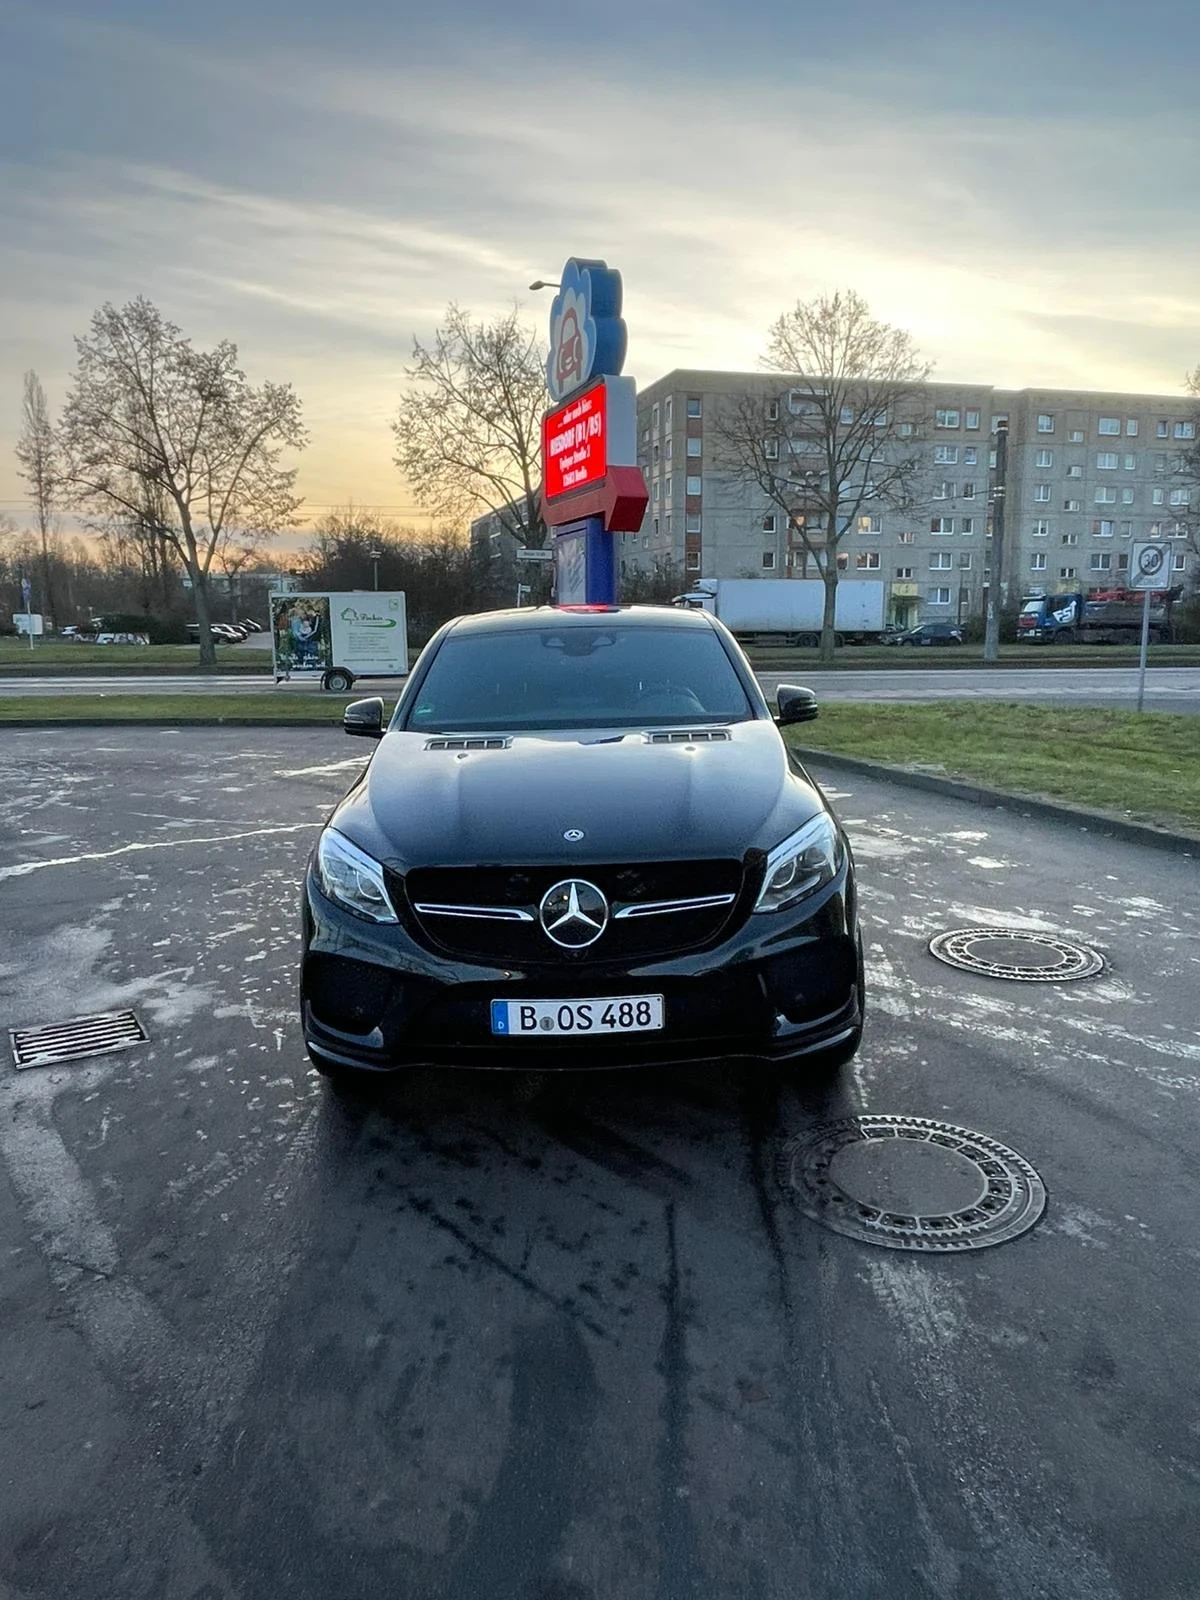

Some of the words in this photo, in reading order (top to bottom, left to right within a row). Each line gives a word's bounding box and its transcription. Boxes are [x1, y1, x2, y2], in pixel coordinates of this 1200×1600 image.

[1143, 553, 1159, 568] 30
[520, 1006, 537, 1031] B
[557, 1005, 593, 1031] OS
[601, 1001, 651, 1028] 488
